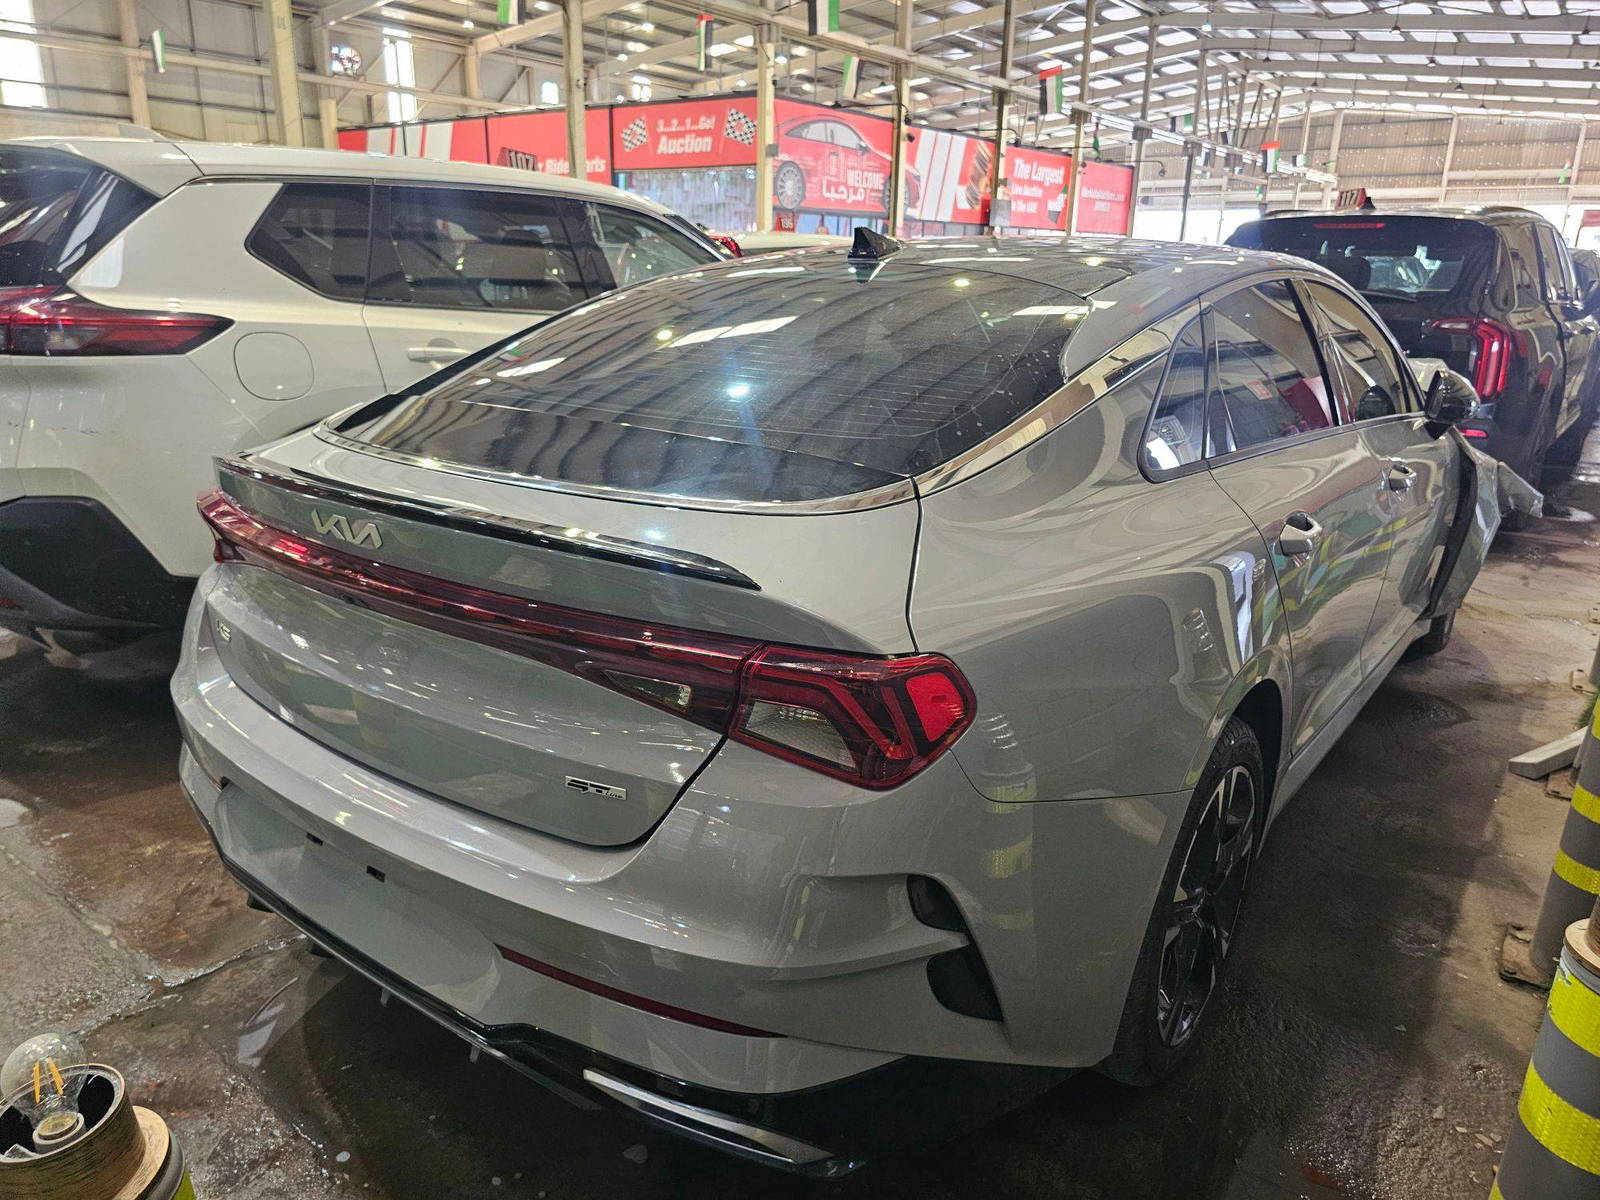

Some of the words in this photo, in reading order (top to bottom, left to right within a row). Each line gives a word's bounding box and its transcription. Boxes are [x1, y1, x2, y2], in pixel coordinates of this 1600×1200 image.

[657, 133, 713, 154] Auction
[585, 156, 606, 173] arts
[1014, 158, 1031, 180] The
[1031, 161, 1065, 187] Largest
[822, 176, 865, 204] مرحبا
[847, 168, 884, 190] WELCOME
[1340, 190, 1359, 207] 117
[312, 508, 383, 549] KIA
